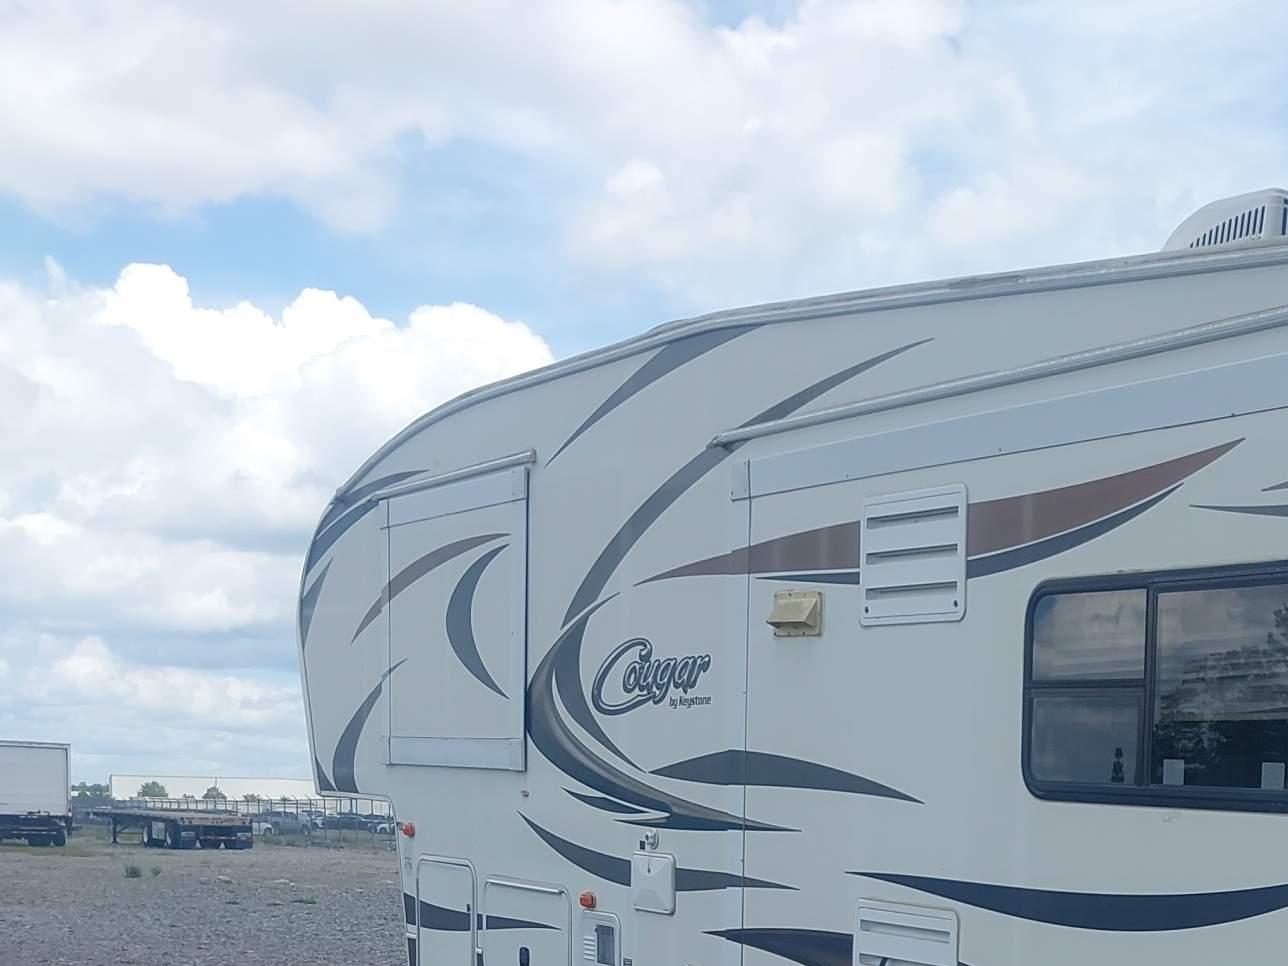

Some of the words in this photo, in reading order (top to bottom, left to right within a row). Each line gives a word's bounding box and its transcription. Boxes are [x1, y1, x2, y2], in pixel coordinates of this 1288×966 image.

[591, 637, 711, 715] Cougar
[669, 695, 678, 709] by
[678, 695, 711, 709] Keystone
